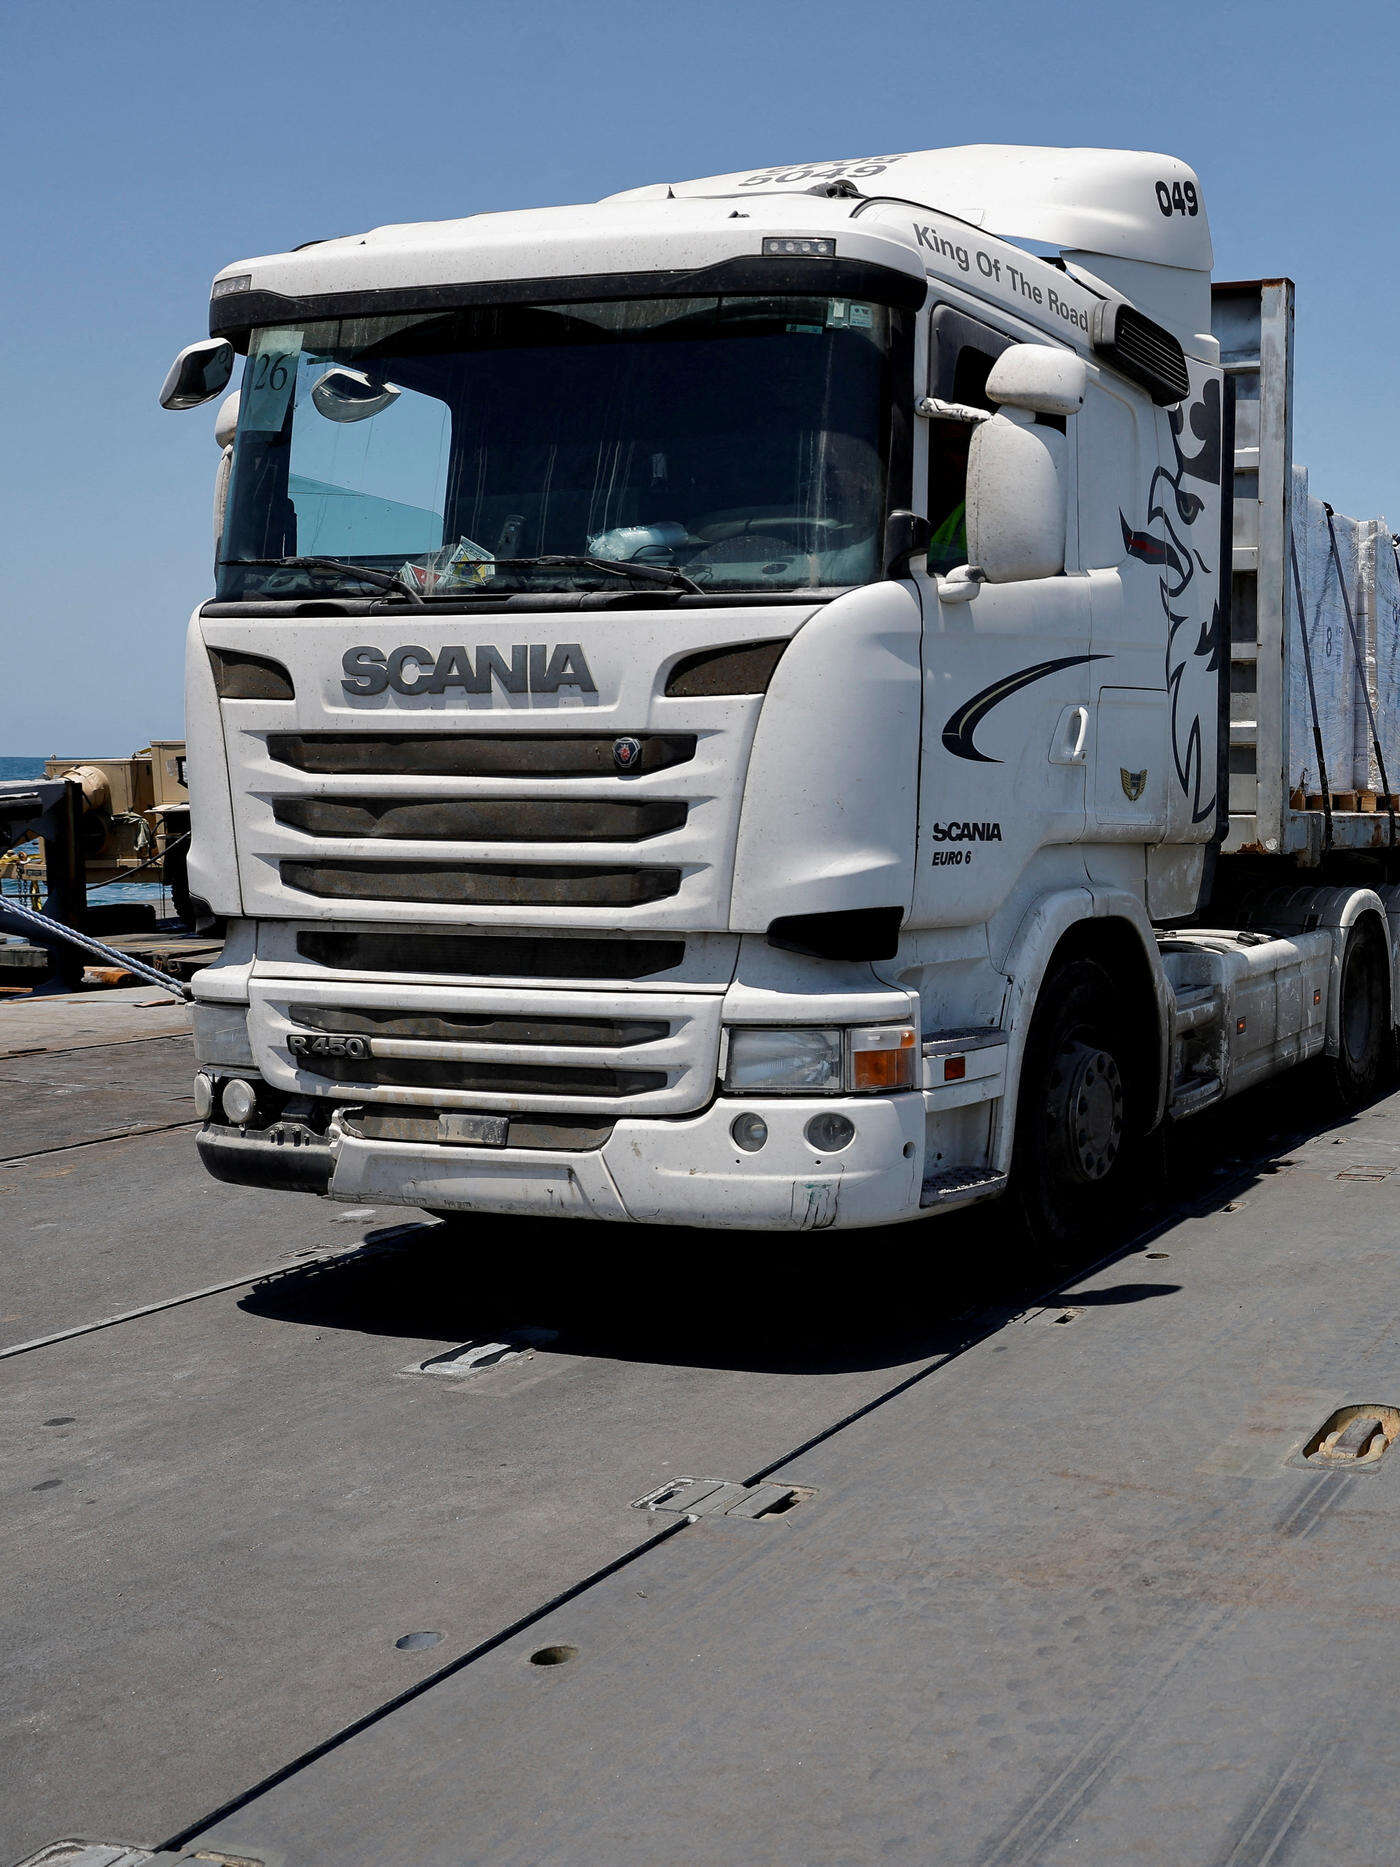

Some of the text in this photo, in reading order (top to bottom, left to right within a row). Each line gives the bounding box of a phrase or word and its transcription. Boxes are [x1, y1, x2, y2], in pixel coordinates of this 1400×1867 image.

[738, 164, 887, 187] 5049
[1155, 180, 1198, 217] 049
[912, 223, 1089, 333] King Of The Road
[254, 352, 294, 391] 26
[340, 643, 598, 696] SCANIA
[932, 821, 1002, 841] SCANIA
[932, 850, 972, 866] EURO 6
[289, 1035, 364, 1055] R 450
